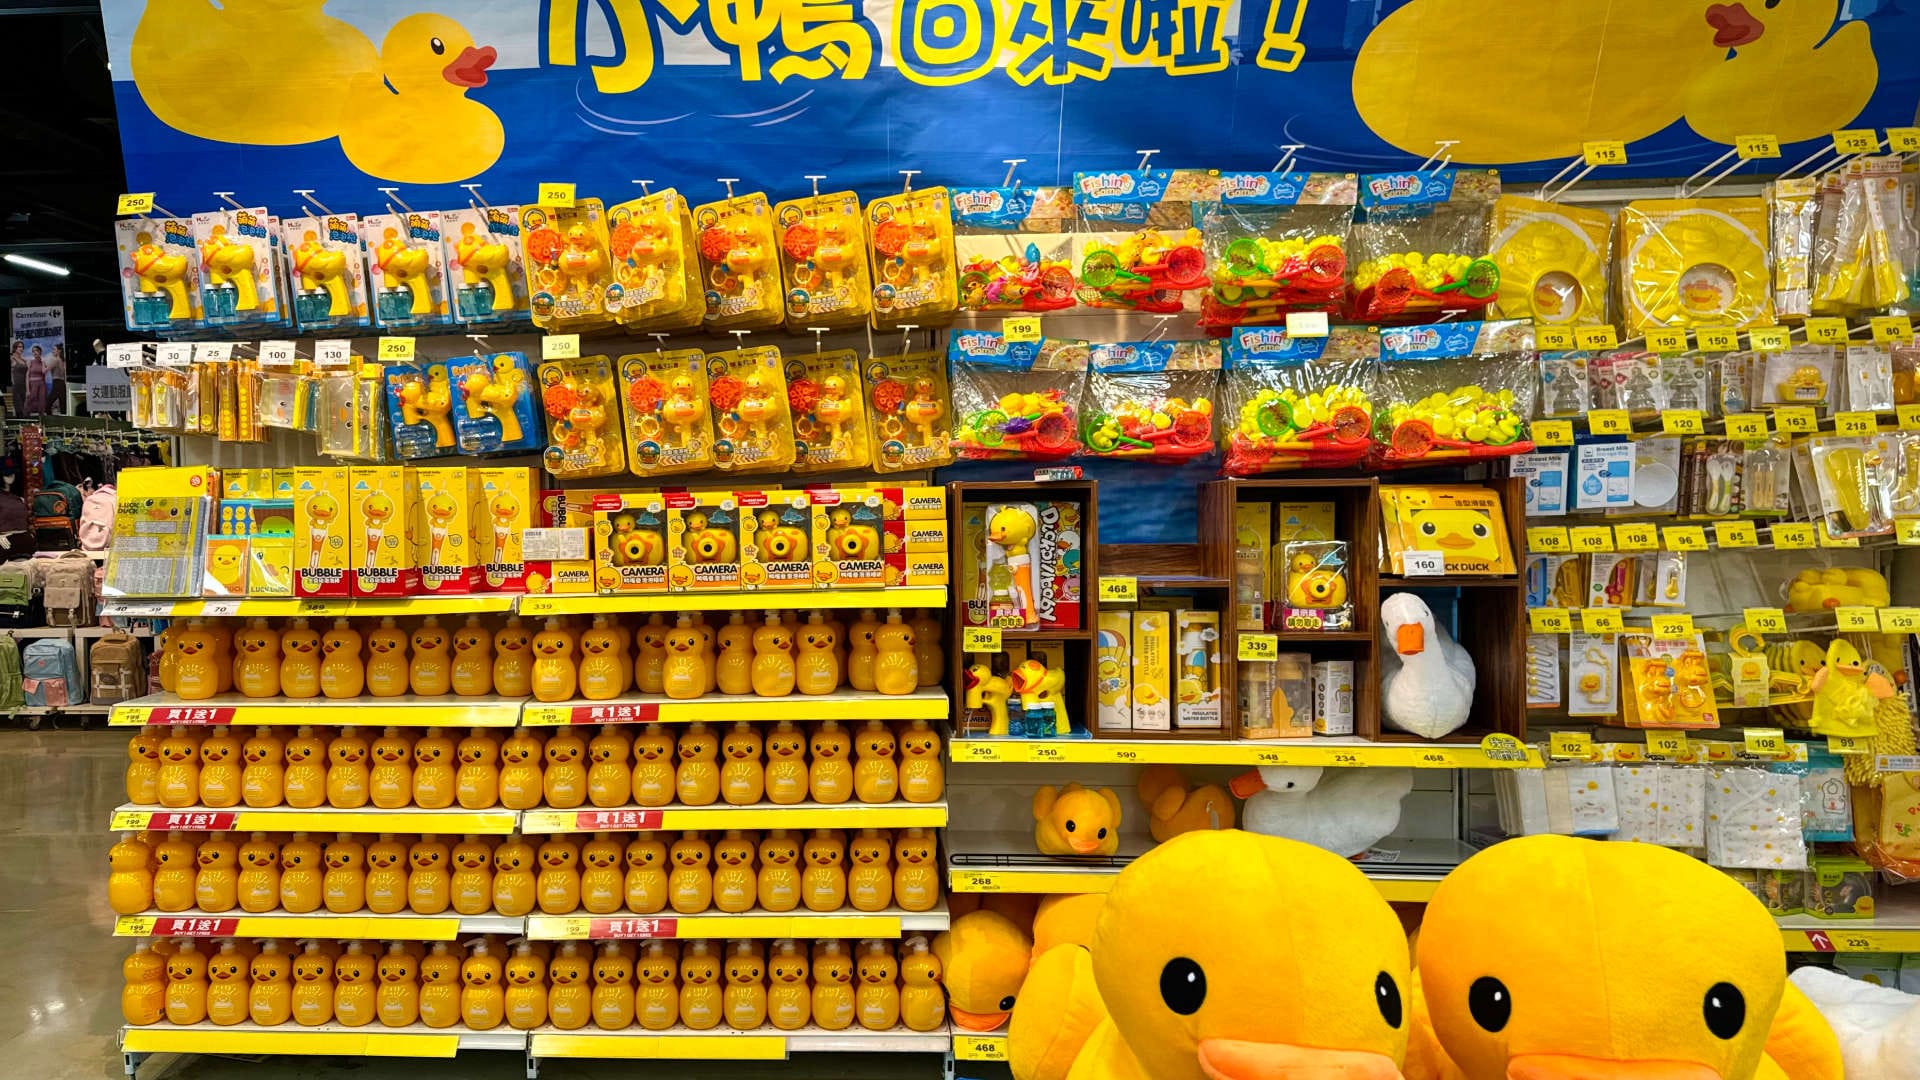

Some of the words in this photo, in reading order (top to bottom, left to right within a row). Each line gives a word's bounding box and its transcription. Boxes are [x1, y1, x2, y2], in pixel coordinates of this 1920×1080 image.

[1846, 138, 1868, 148] 125
[1902, 137, 1917, 146] 85
[1748, 143, 1769, 153] 115
[1595, 150, 1616, 160] 115
[1082, 176, 1134, 193] Fishing
[1220, 176, 1269, 194] Fishing
[1372, 178, 1420, 194] Fishing
[547, 191, 566, 200] 250
[126, 198, 145, 207] 250
[1012, 324, 1032, 334] 199
[1816, 328, 1838, 337] 157
[1886, 327, 1900, 336] 80
[1242, 332, 1293, 350] Fishing
[1544, 336, 1564, 344] 150
[1586, 335, 1607, 344] 150
[1656, 337, 1677, 346] 150
[1708, 336, 1728, 345] 150
[1761, 337, 1781, 346] 105
[551, 342, 571, 351] 250
[960, 336, 1007, 353] Fishing
[119, 353, 131, 362] 50
[167, 352, 179, 361] 30
[1603, 420, 1617, 428] 89
[1673, 419, 1693, 428] 120
[1785, 418, 1807, 426] 163
[1846, 422, 1867, 431] 218
[1736, 424, 1757, 433] 145
[1546, 431, 1560, 440] 89
[558, 496, 566, 528] BUBBL
[1626, 535, 1648, 543] 108
[1678, 536, 1693, 545] 96
[1730, 532, 1744, 541] 85
[1783, 534, 1805, 543] 145
[1538, 537, 1559, 546] 108
[1582, 537, 1602, 546] 108
[486, 564, 523, 572] BUBBLE
[767, 563, 810, 571] CAMERA
[839, 562, 882, 571] CAMERA
[1414, 560, 1435, 569] 160
[301, 568, 342, 577] BUBBLE
[358, 568, 397, 577] BUBBLE
[423, 566, 461, 574] BUBBLE
[622, 567, 665, 576] CAMERA
[694, 565, 737, 574] CAMERA
[1107, 584, 1128, 594] 468
[1541, 619, 1561, 627] 108
[1596, 619, 1610, 627] 66
[1755, 619, 1776, 627] 130
[1850, 616, 1865, 625] 59
[1891, 618, 1912, 627] 129
[1663, 625, 1684, 634] 229
[972, 634, 993, 643] 389
[1247, 642, 1268, 651] 339
[166, 708, 217, 720] 買1送1
[590, 705, 640, 718] 買1送1
[1658, 740, 1678, 749] 102
[1755, 739, 1775, 748] 108
[1840, 739, 1854, 747] 99
[972, 747, 992, 755] 250
[1561, 744, 1582, 753] 102
[166, 813, 217, 825] 買1送1
[595, 812, 646, 824] 買1送1
[171, 919, 221, 931] 買1送1
[608, 920, 660, 933] 買1送1
[1847, 939, 1869, 947] 229
[975, 1043, 995, 1052] 468
